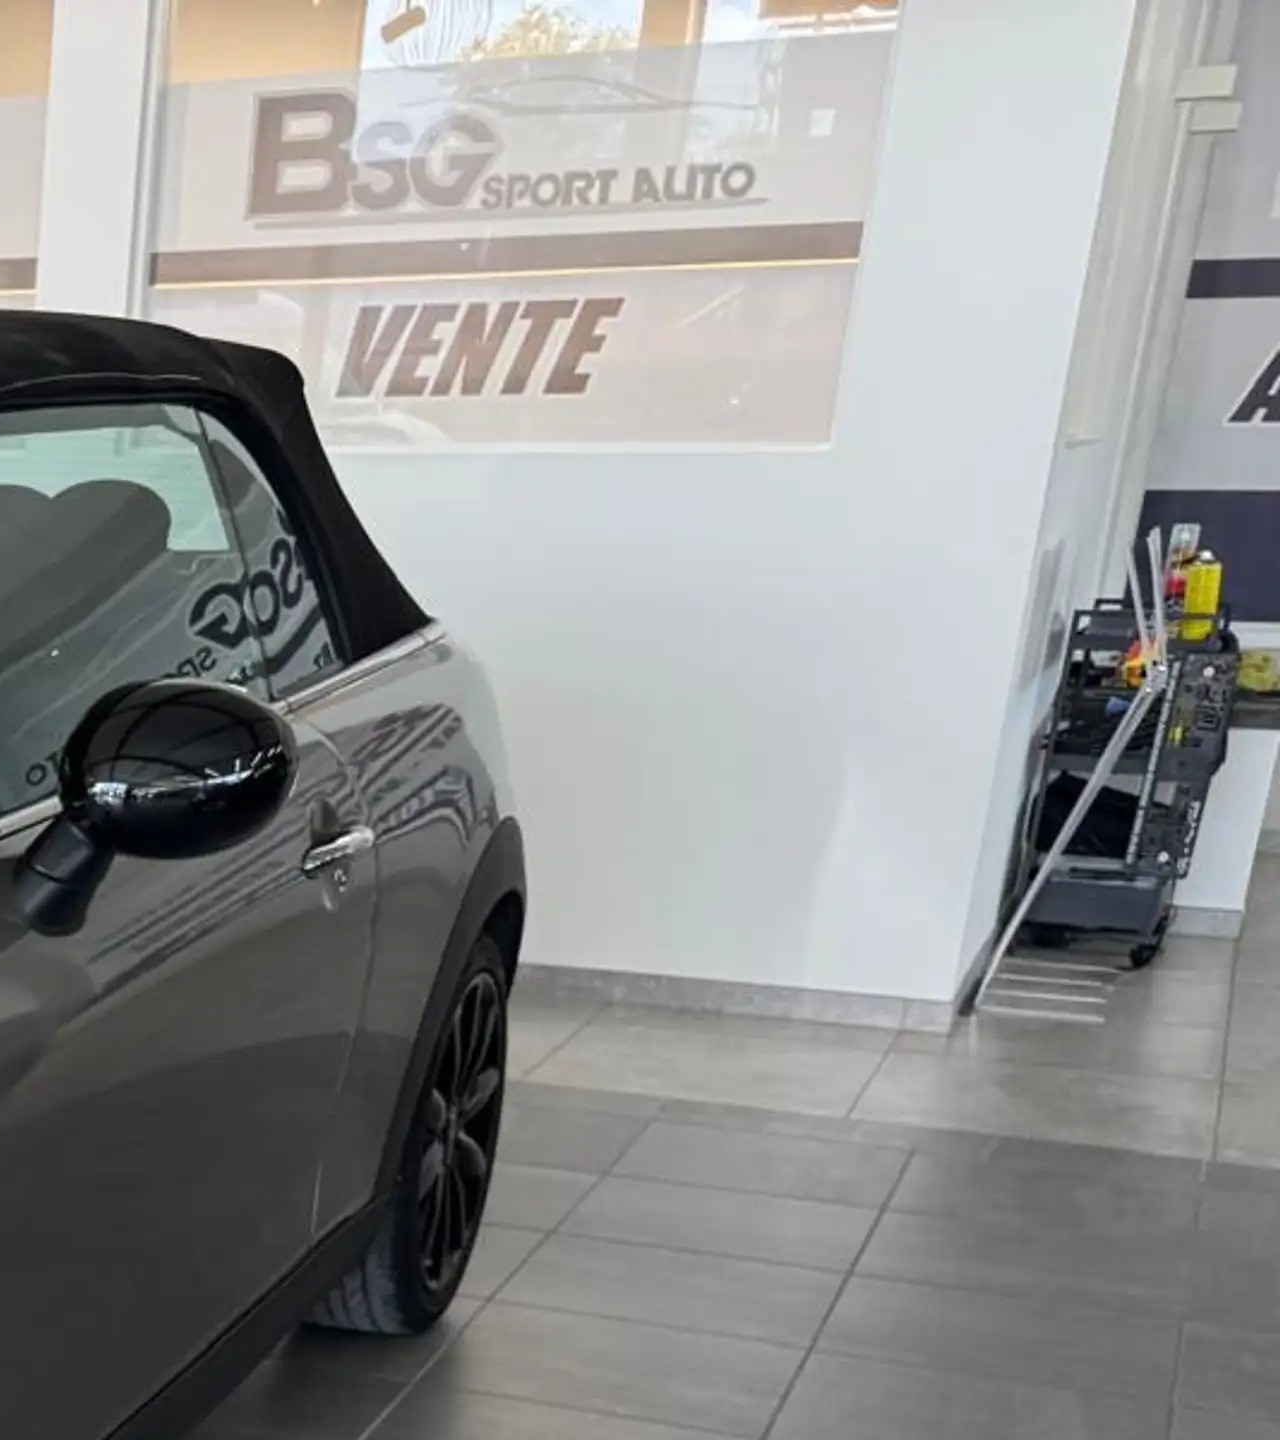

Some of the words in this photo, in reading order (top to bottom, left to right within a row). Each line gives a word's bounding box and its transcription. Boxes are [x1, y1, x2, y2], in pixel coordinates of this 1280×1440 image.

[247, 92, 497, 217] BSG
[481, 168, 618, 211] SPORT
[632, 162, 757, 204] AUTO
[335, 297, 626, 398] VENTE
